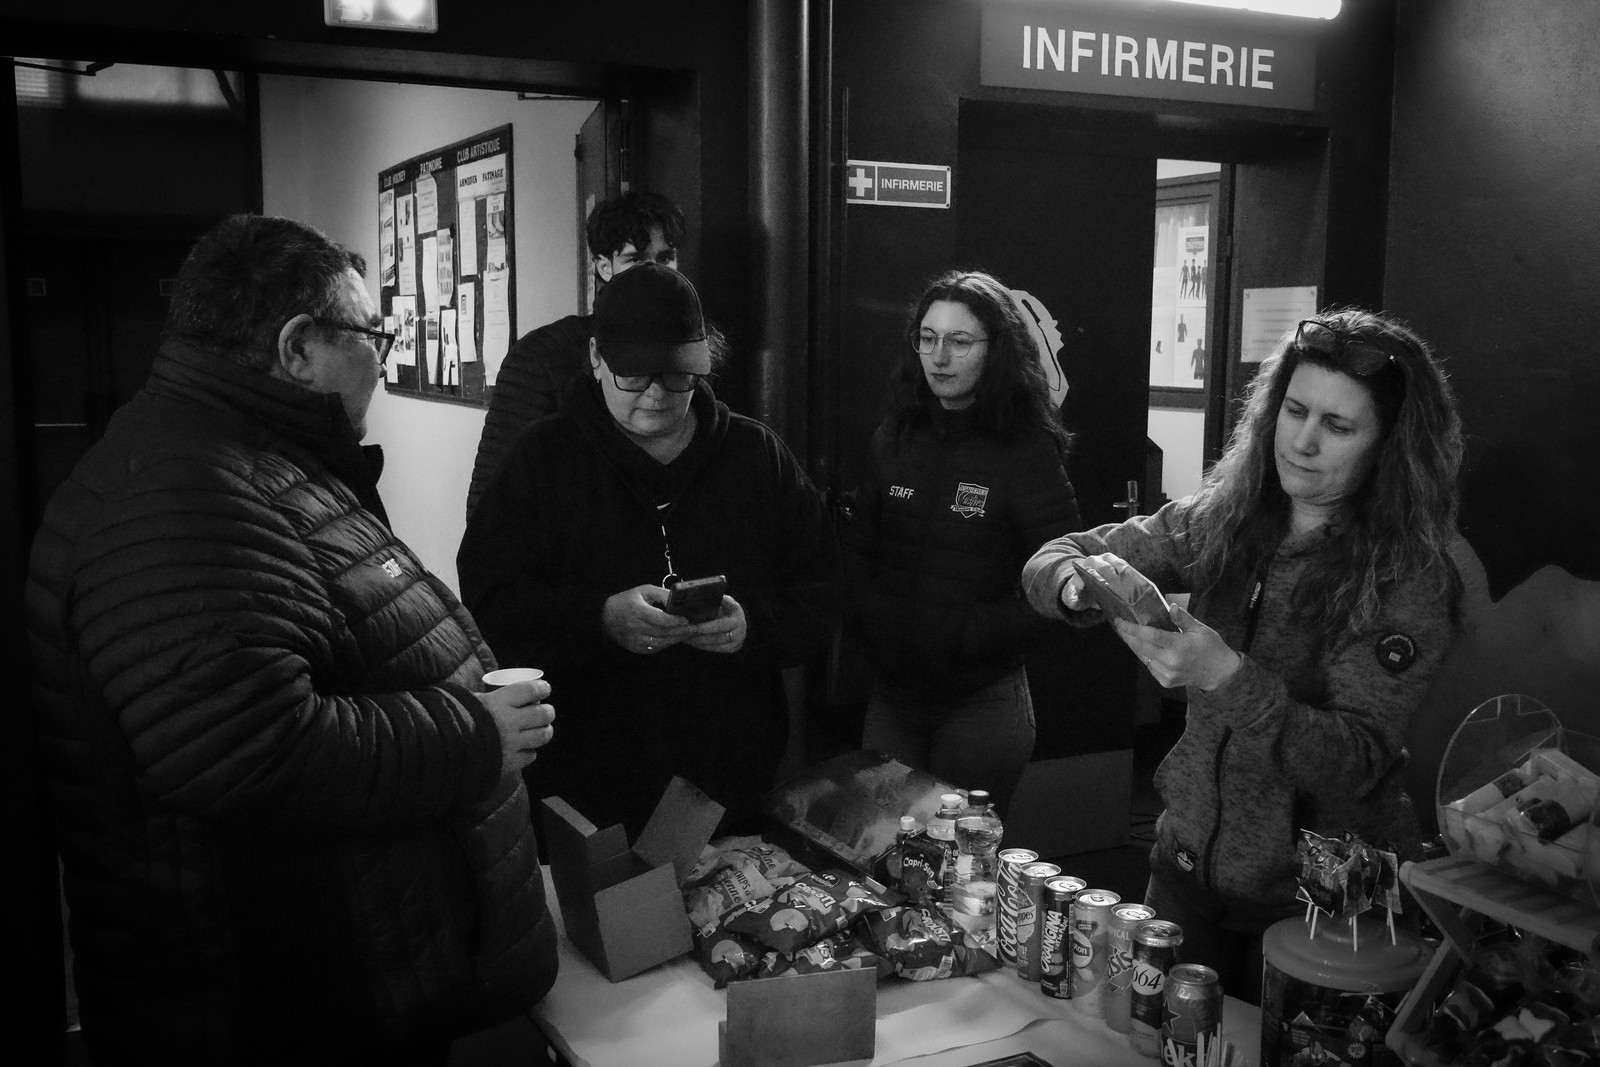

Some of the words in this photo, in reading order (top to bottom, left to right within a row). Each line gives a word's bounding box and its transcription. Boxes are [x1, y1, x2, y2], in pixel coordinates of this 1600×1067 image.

[1021, 24, 1276, 90] INFIRMERIE
[881, 178, 945, 193] INFIRMERIE
[889, 485, 915, 500] STAFF
[903, 857, 936, 879] Capri-Sun
[1041, 910, 1063, 974] ORANGINA
